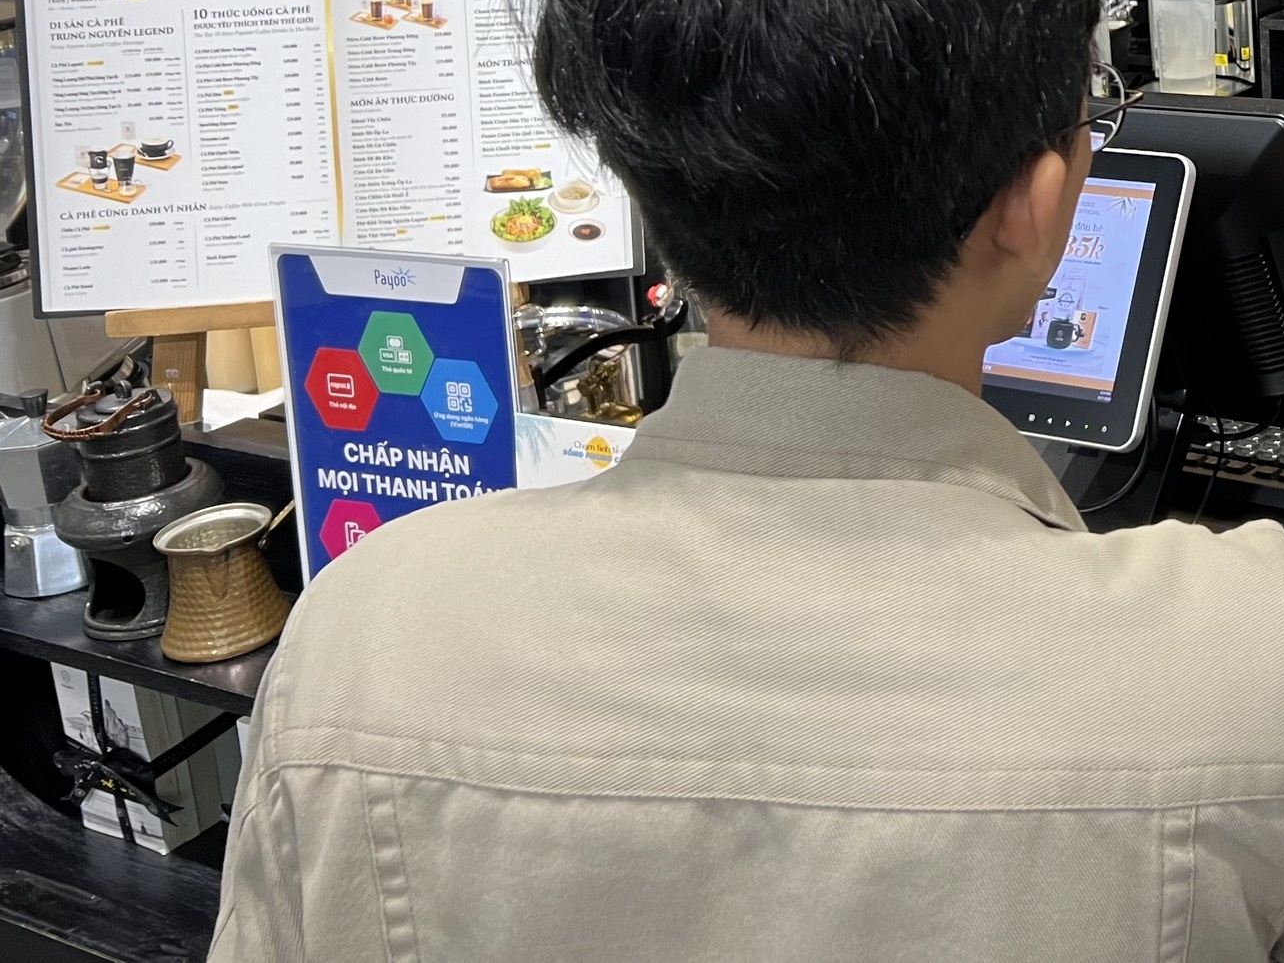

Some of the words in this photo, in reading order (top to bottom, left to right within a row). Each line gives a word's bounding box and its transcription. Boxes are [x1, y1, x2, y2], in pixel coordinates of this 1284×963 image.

[193, 9, 208, 19] 10
[212, 8, 240, 18] THỨC
[242, 6, 273, 17] UỐNG
[275, 6, 288, 14] CÀ
[291, 5, 311, 14] PHÊ
[49, 21, 61, 29] DI
[64, 18, 84, 28] SẢN
[87, 18, 101, 27] CÀ
[104, 17, 124, 26] PHÊ
[193, 22, 216, 30] ĐƯỢC
[217, 20, 232, 28] YÊU
[233, 19, 258, 27] THÍCH
[260, 18, 279, 26] TRÊN
[297, 16, 314, 24] GIỚI
[50, 31, 90, 41] TRUNG
[92, 28, 131, 39] NGUYÊN
[134, 26, 174, 36] LEGEND
[477, 60, 500, 68] MÓN
[351, 97, 373, 107] MÓN
[375, 96, 389, 105] ĂN
[390, 95, 417, 105] THỰC
[420, 93, 455, 103] DƯỠNG
[60, 209, 74, 220] CÀ
[76, 208, 97, 219] PHÊ
[98, 206, 129, 218] CÙNG
[131, 205, 161, 216] DANH
[177, 202, 207, 212] NHÂN
[374, 268, 407, 290] Payoo
[474, 416, 489, 425] hàng
[343, 440, 404, 468] CHẤP
[407, 447, 471, 478] NHẬN
[317, 468, 359, 496] MỌI
[361, 474, 438, 502] THANH
[441, 479, 501, 501] TOÁ
